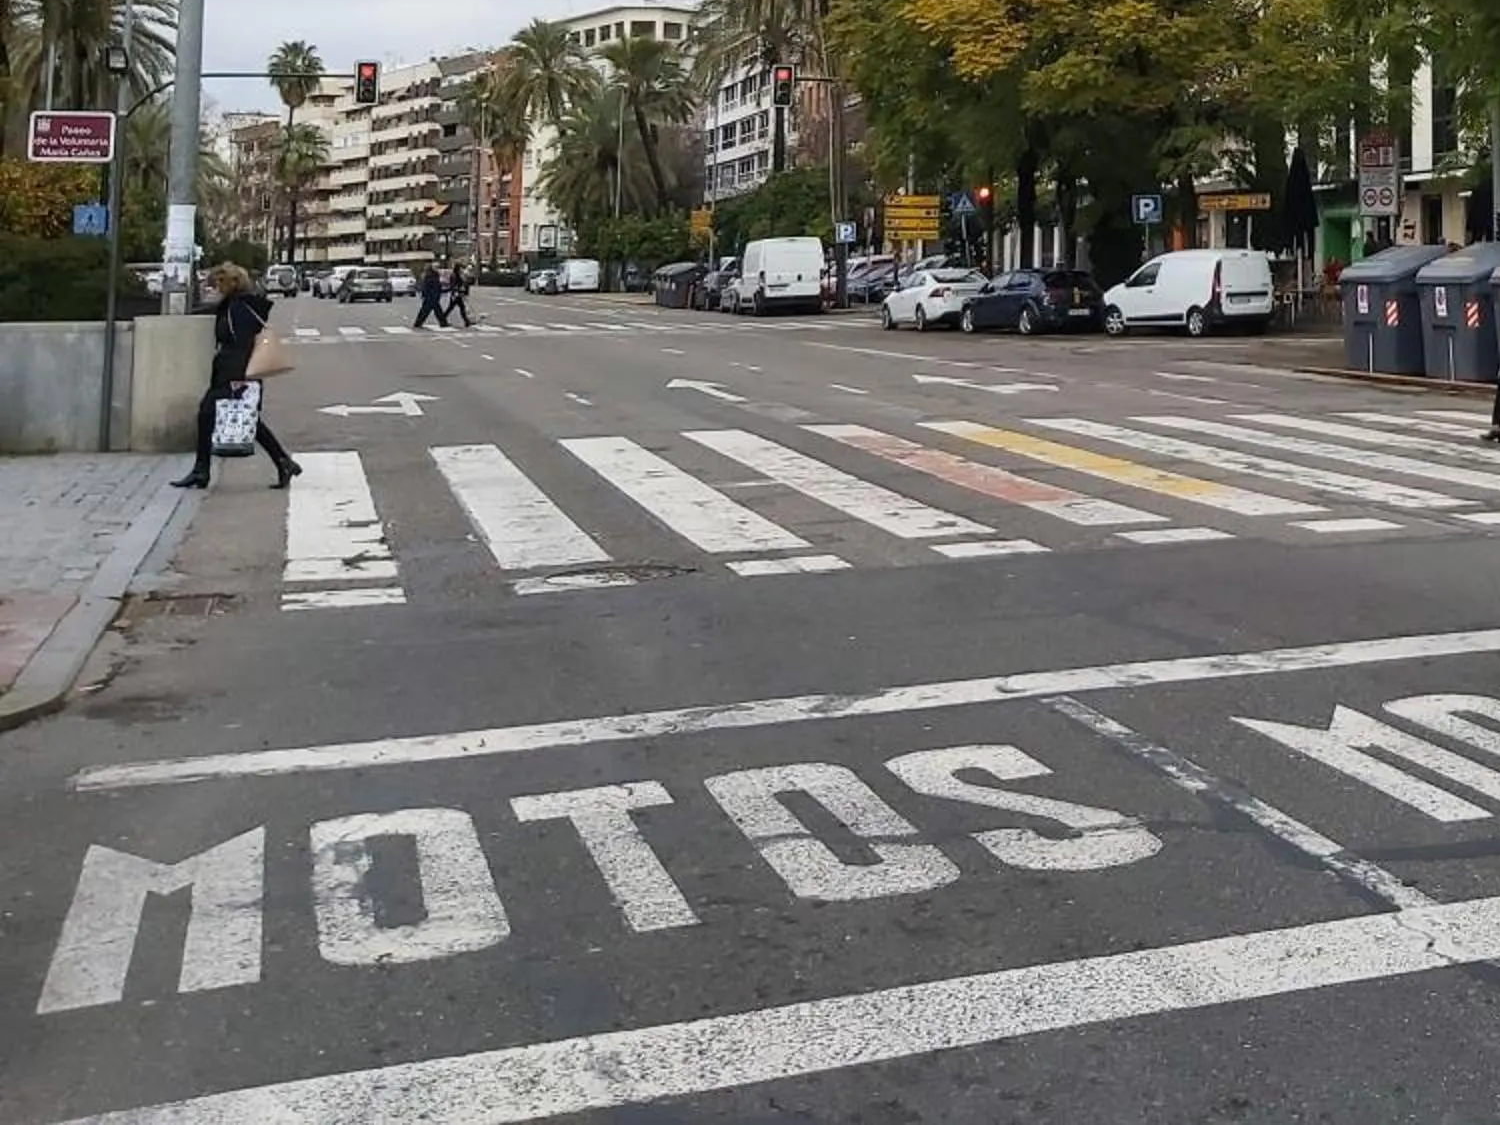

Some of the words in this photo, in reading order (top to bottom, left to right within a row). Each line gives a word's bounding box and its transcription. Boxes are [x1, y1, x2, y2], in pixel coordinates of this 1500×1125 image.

[61, 124, 92, 135] Paseo
[32, 136, 48, 146] de
[60, 136, 108, 146] Voluntaria
[1139, 198, 1155, 220] P
[840, 225, 853, 240] P
[35, 742, 1165, 1015] MOTOS
